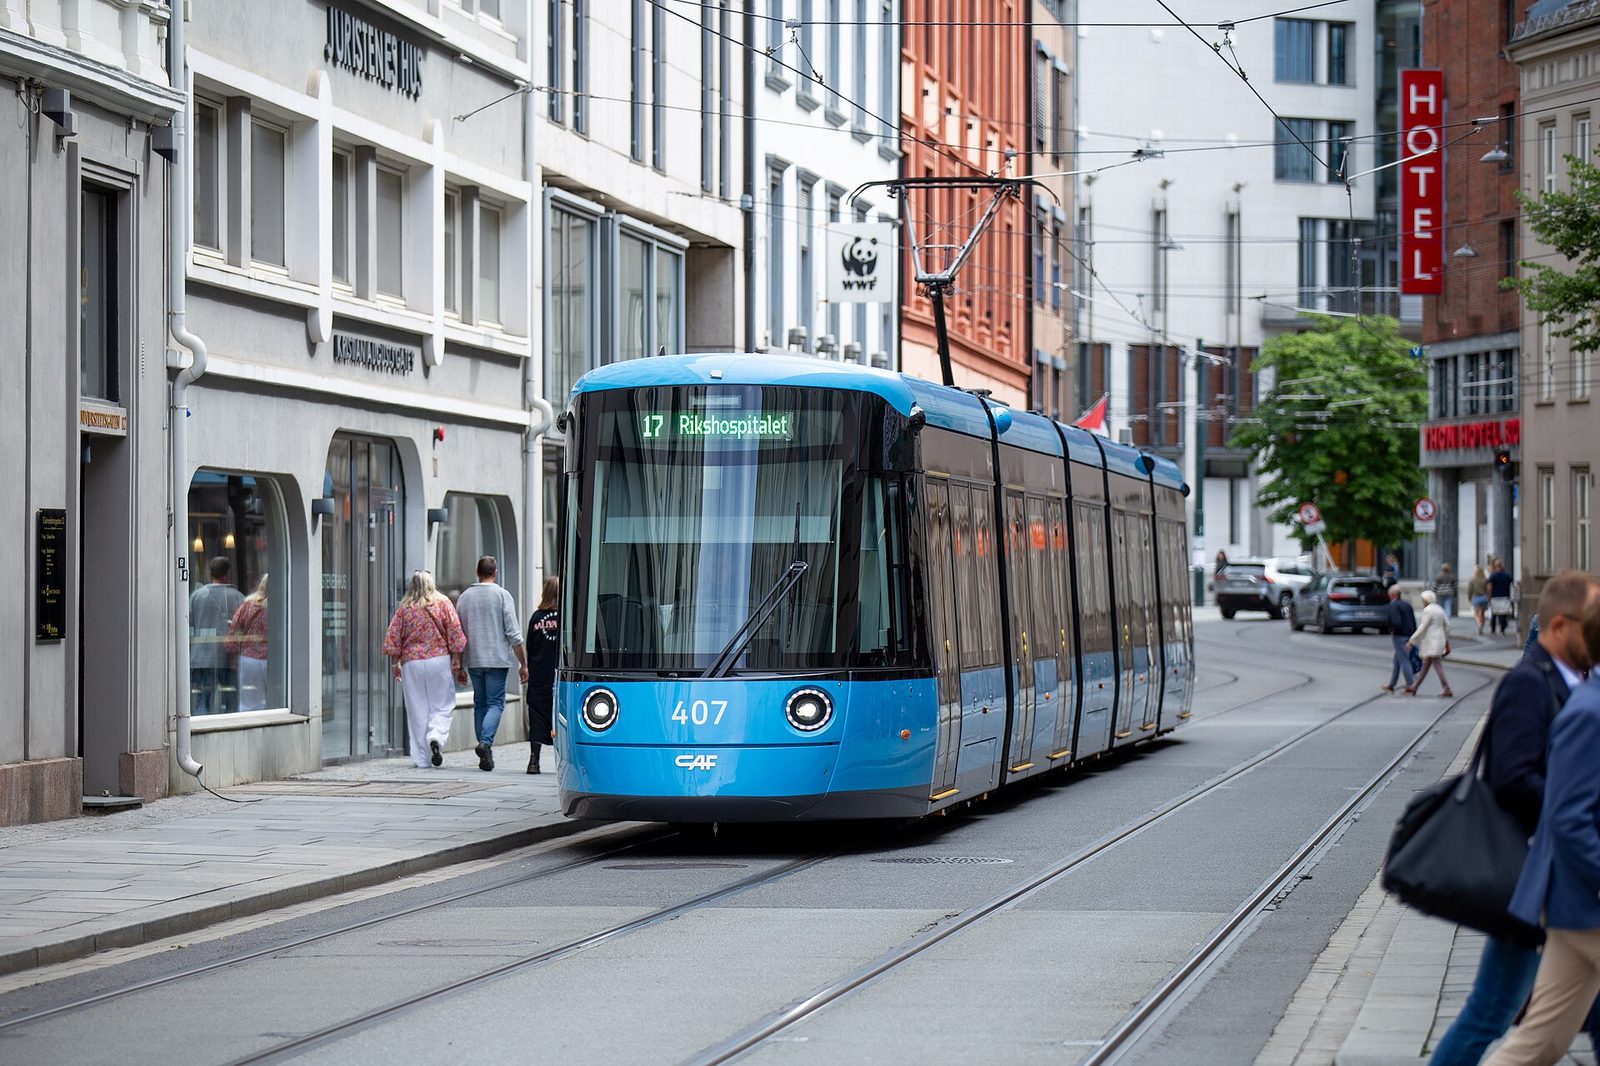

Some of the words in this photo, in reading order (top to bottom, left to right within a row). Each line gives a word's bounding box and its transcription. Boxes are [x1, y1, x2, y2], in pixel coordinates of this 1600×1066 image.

[325, 6, 398, 90] JURISTENES
[398, 40, 423, 98] HUS
[1406, 83, 1438, 281] HOTEL
[842, 280, 876, 290] WWF
[643, 415, 664, 437] 17
[679, 415, 788, 439] Rikshospitalet
[1424, 425, 1459, 451] THON
[1460, 421, 1503, 448] HOTEL
[671, 700, 728, 725] 407
[675, 754, 718, 771] CAF
